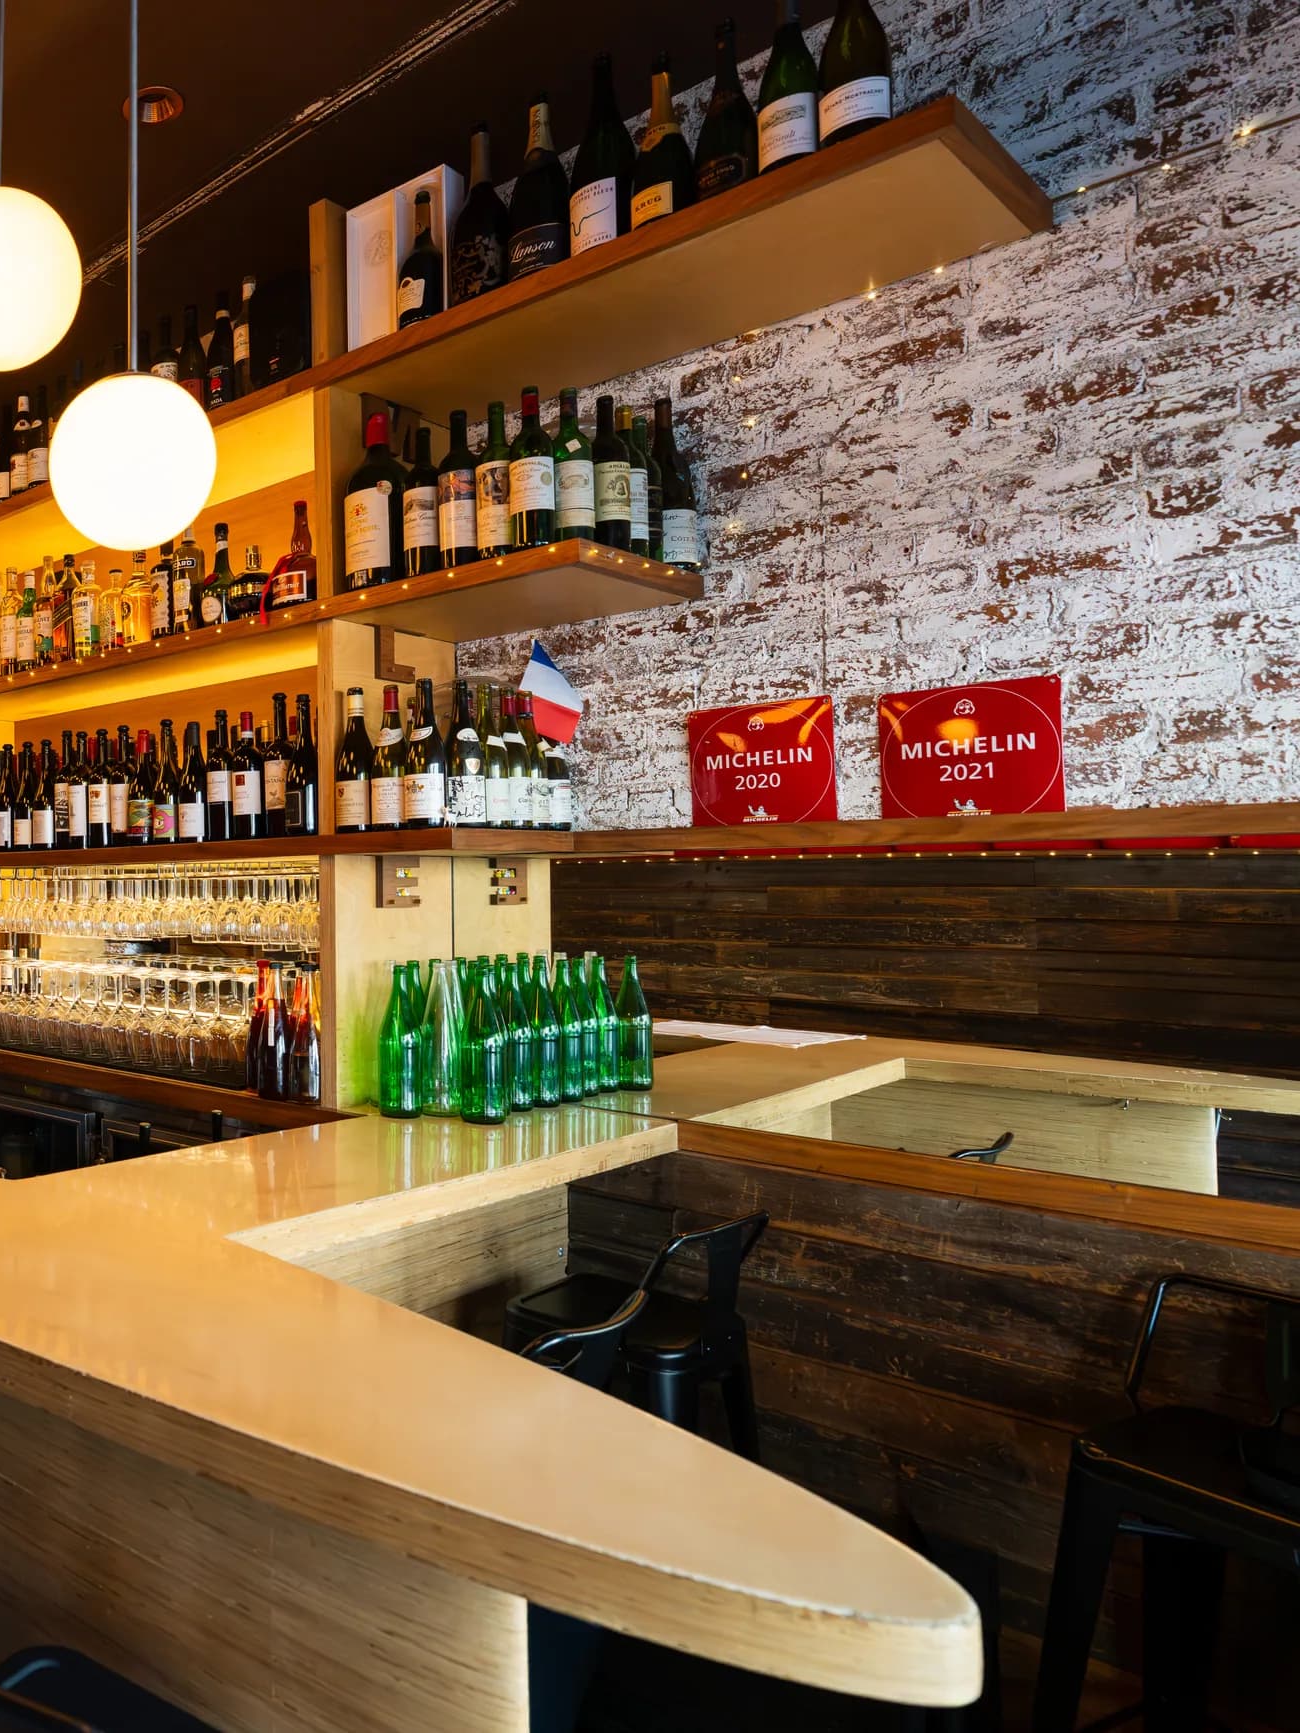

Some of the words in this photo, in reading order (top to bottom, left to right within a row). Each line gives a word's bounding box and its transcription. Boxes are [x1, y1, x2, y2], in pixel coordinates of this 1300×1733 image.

[635, 195, 662, 213] KRUG
[510, 241, 557, 264] Lanson
[901, 732, 1036, 760] MICHELIN
[706, 747, 813, 770] MICHELIN
[734, 772, 781, 790] 2020
[939, 761, 994, 782] 2021
[742, 815, 778, 823] MICHELIN
